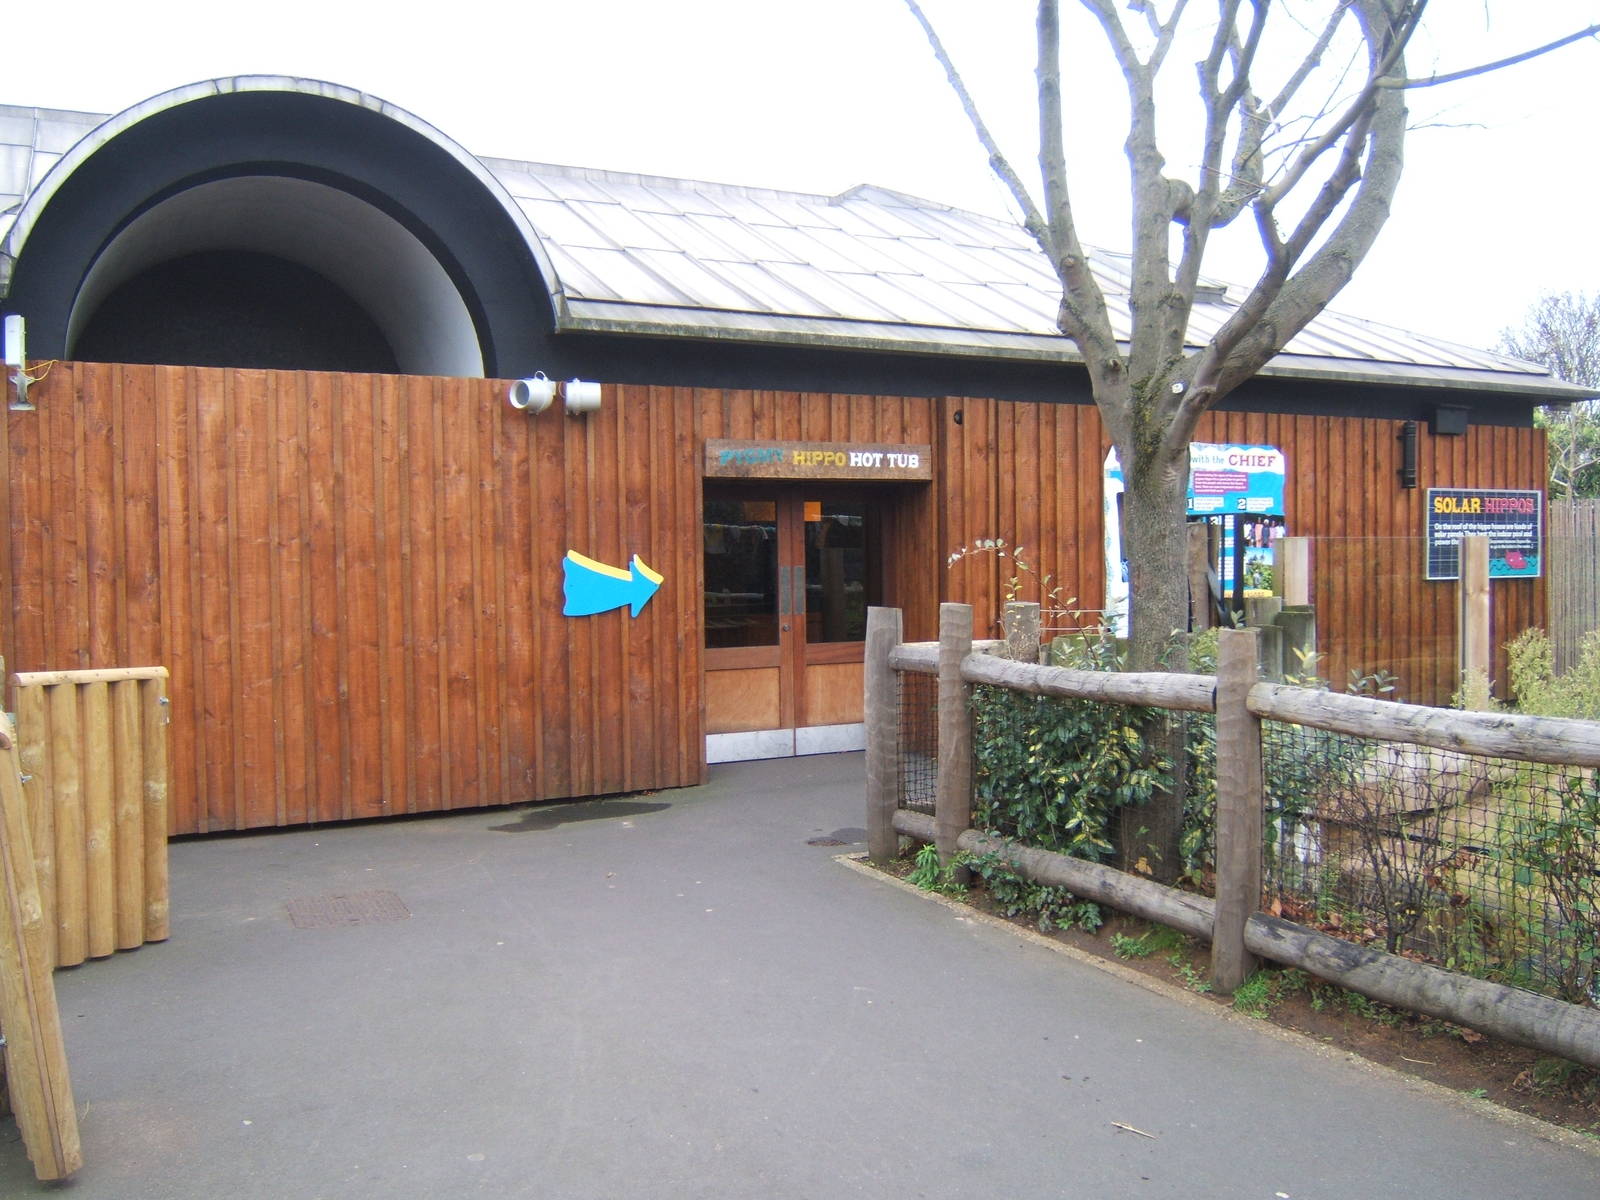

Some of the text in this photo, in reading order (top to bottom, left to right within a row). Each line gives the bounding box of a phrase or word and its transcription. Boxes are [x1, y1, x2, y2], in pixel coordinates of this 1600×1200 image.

[793, 450, 846, 467] HIPPO
[850, 452, 883, 468] HOT
[887, 453, 919, 469] TUB
[1192, 454, 1276, 467] with the CHIEF
[1187, 498, 1194, 510] 1
[1237, 498, 1247, 511] 2
[1434, 496, 1534, 514] SOLAR HIPPOS
